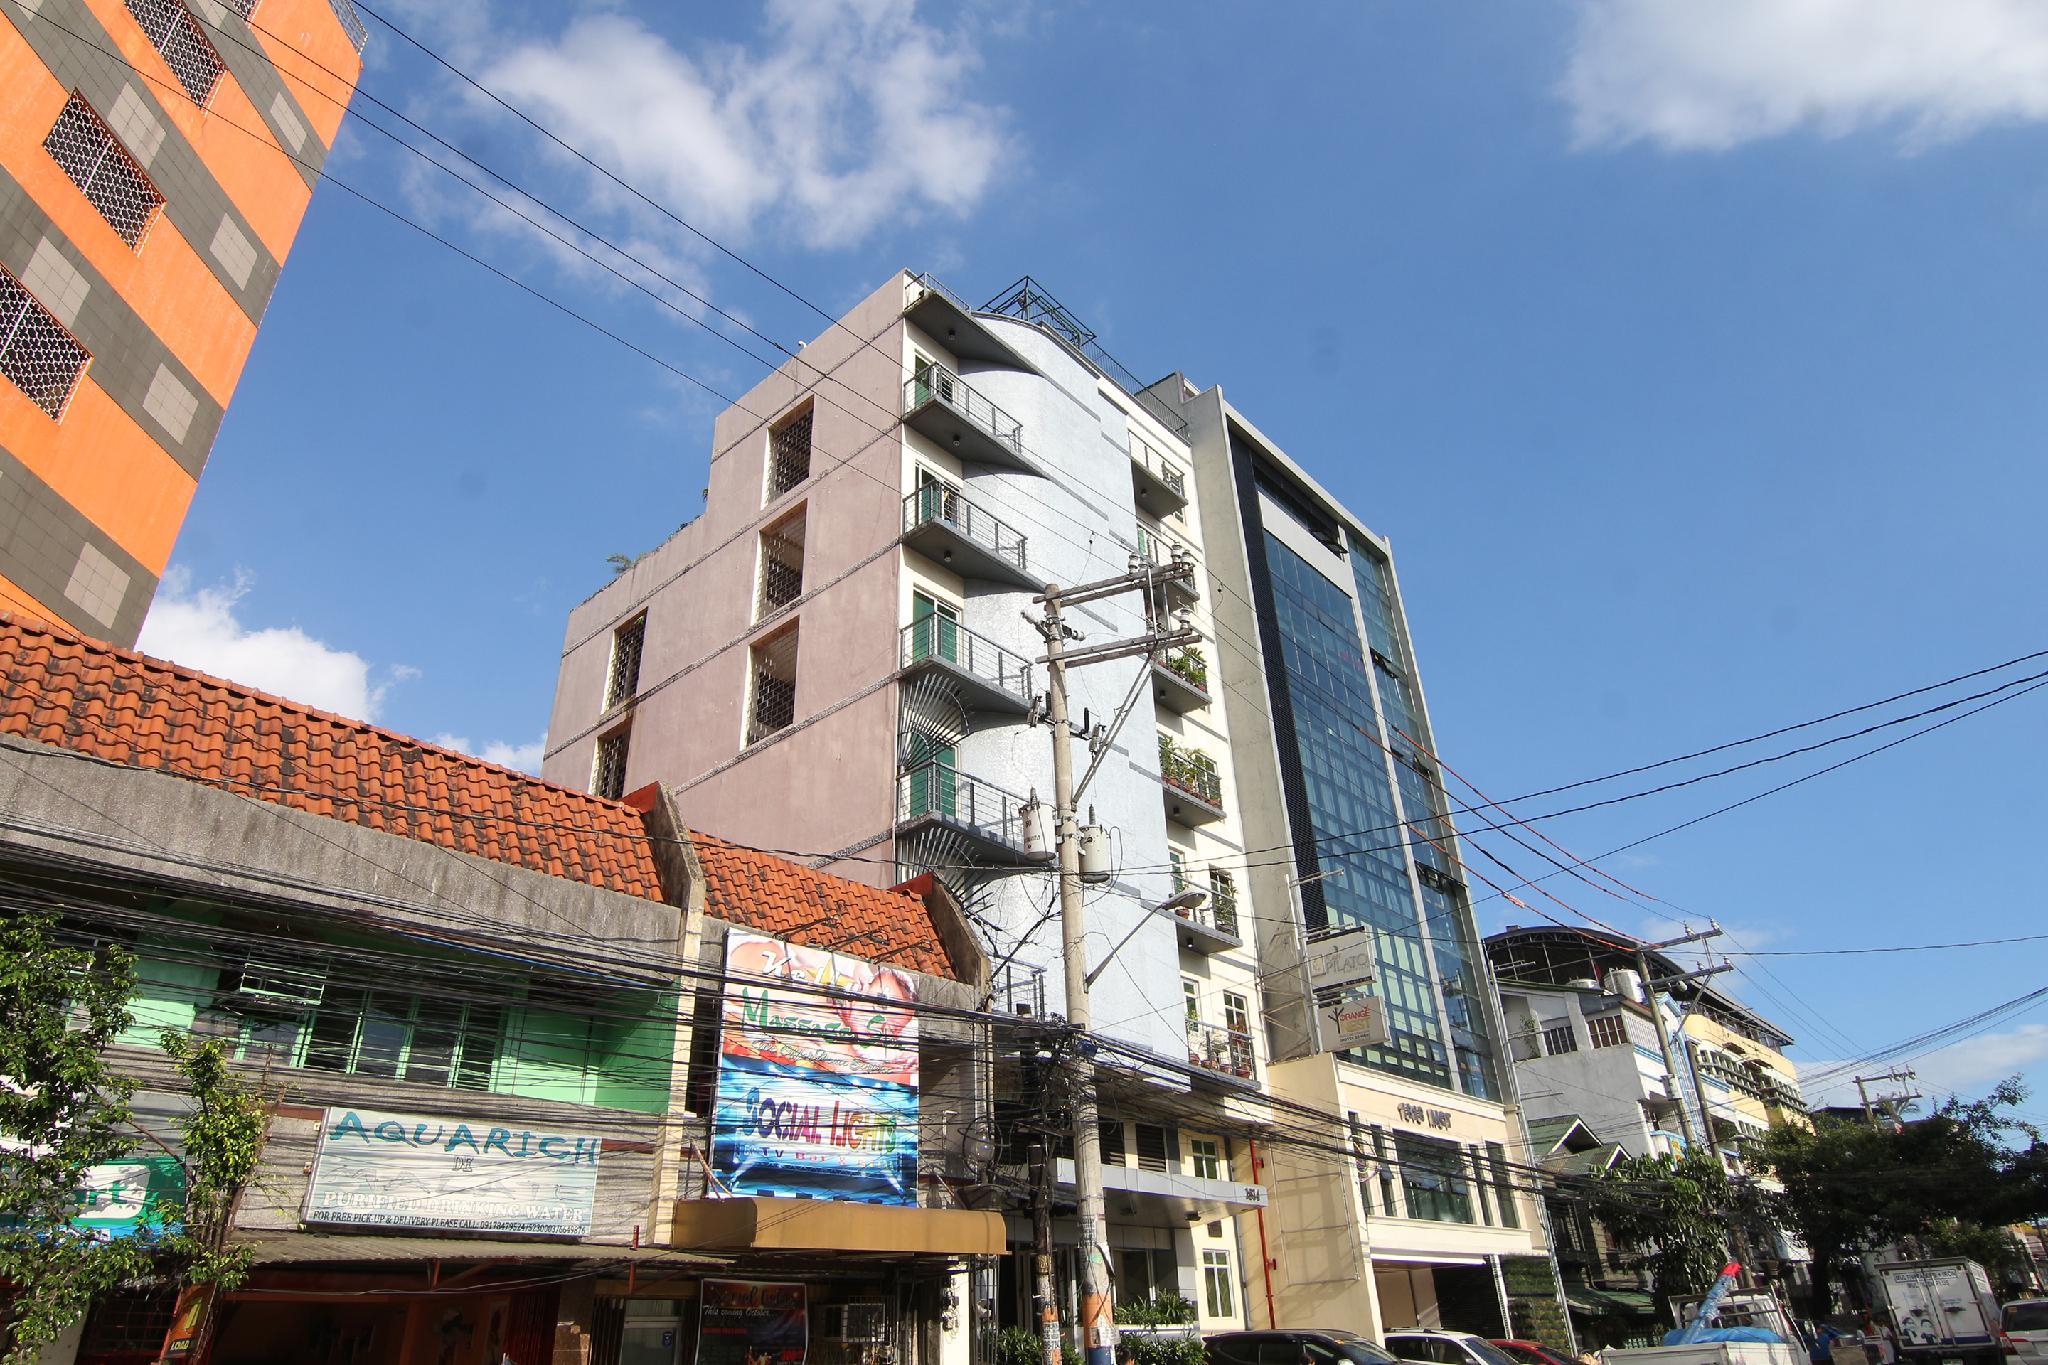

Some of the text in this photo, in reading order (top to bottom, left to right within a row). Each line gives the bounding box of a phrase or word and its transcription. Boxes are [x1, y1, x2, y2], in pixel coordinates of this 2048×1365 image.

[330, 1111, 598, 1166] AQUARICH
[313, 1210, 330, 1221] FOR
[331, 1211, 352, 1222] FREE
[353, 1213, 386, 1225] PICK-UP
[394, 1215, 431, 1227] DELIVERY
[431, 1218, 459, 1229] PLEASE
[322, 1191, 585, 1222] PURIFIED DRINKING WATER
